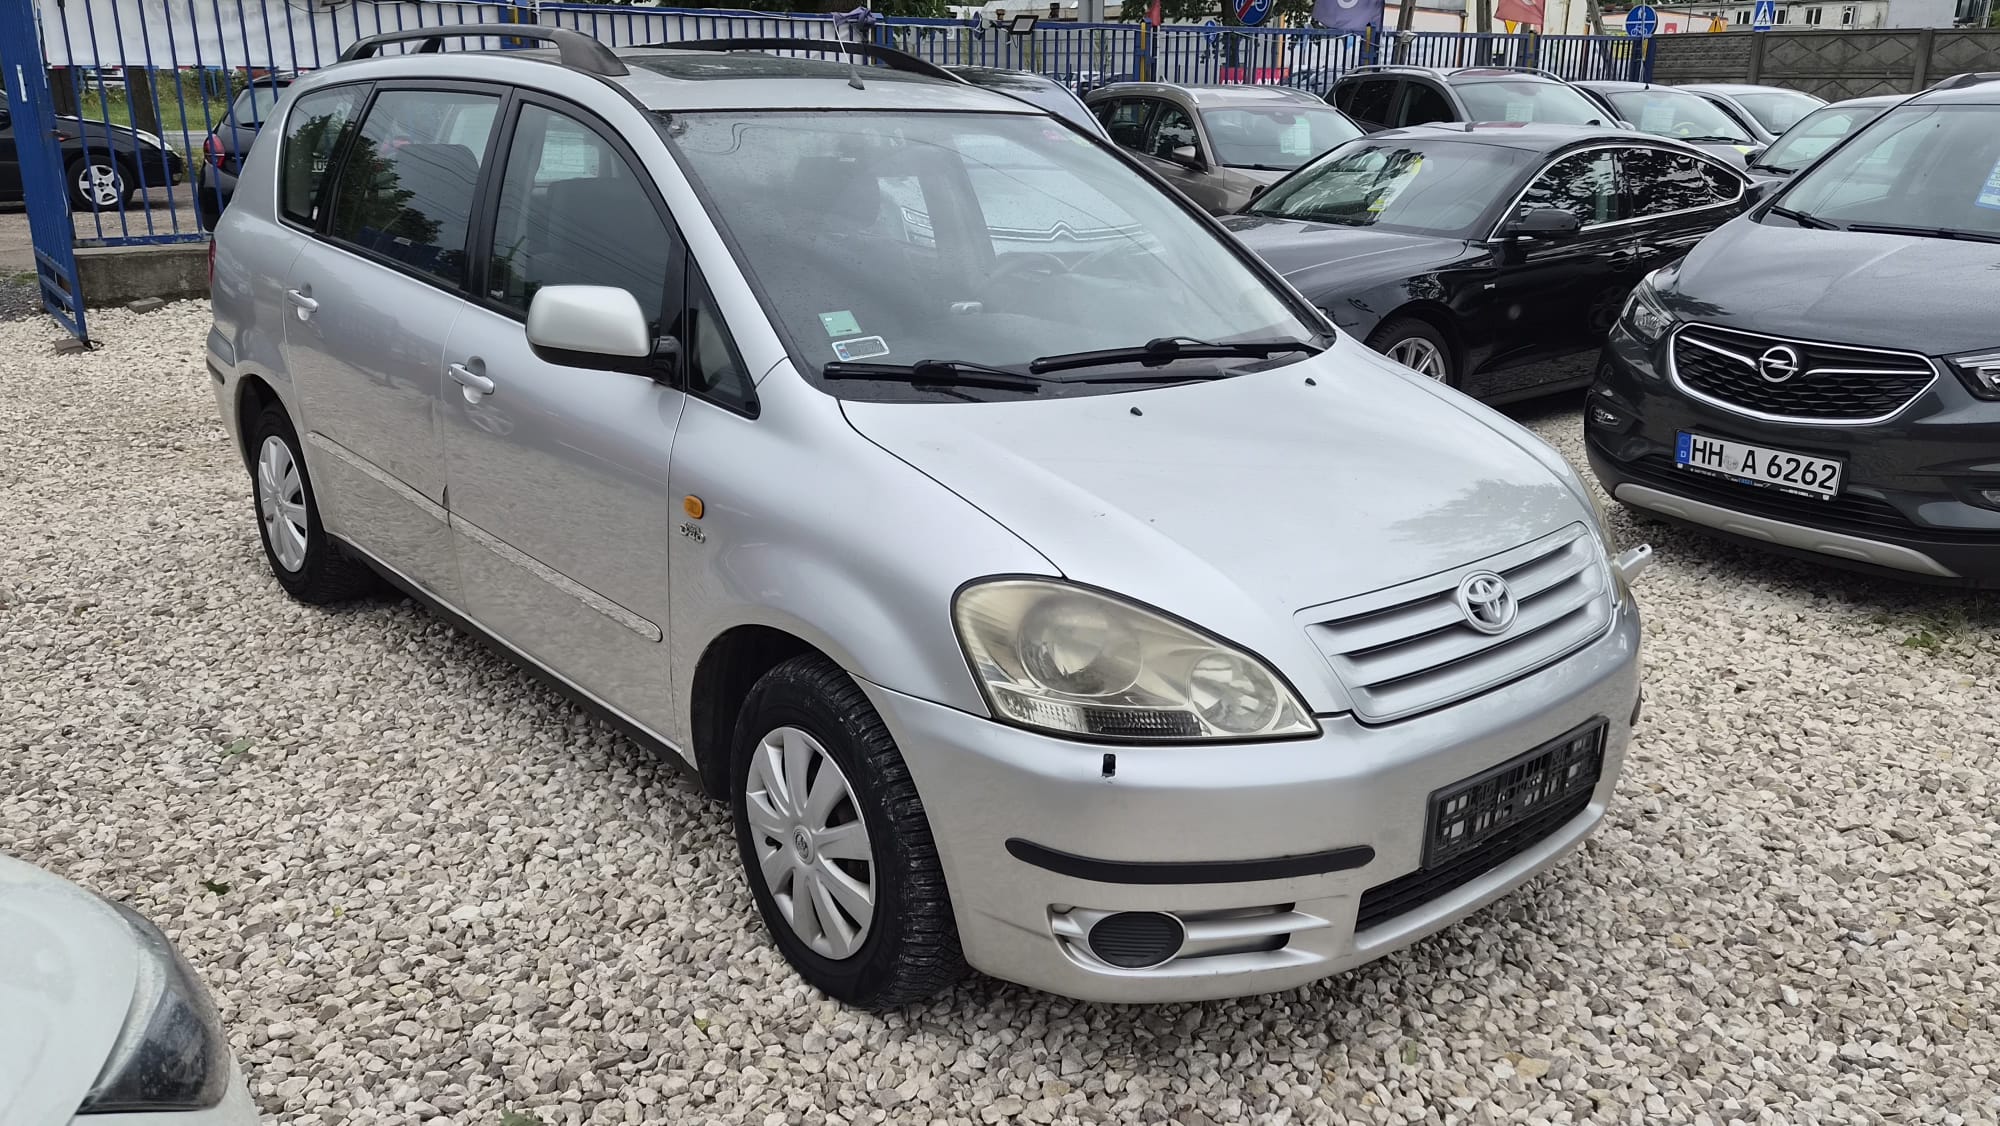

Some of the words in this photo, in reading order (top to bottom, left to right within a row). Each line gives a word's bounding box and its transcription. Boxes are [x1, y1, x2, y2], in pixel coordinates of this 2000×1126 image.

[1692, 439, 1724, 467] HH
[1741, 449, 1757, 475] A
[1766, 455, 1837, 490] 6262
